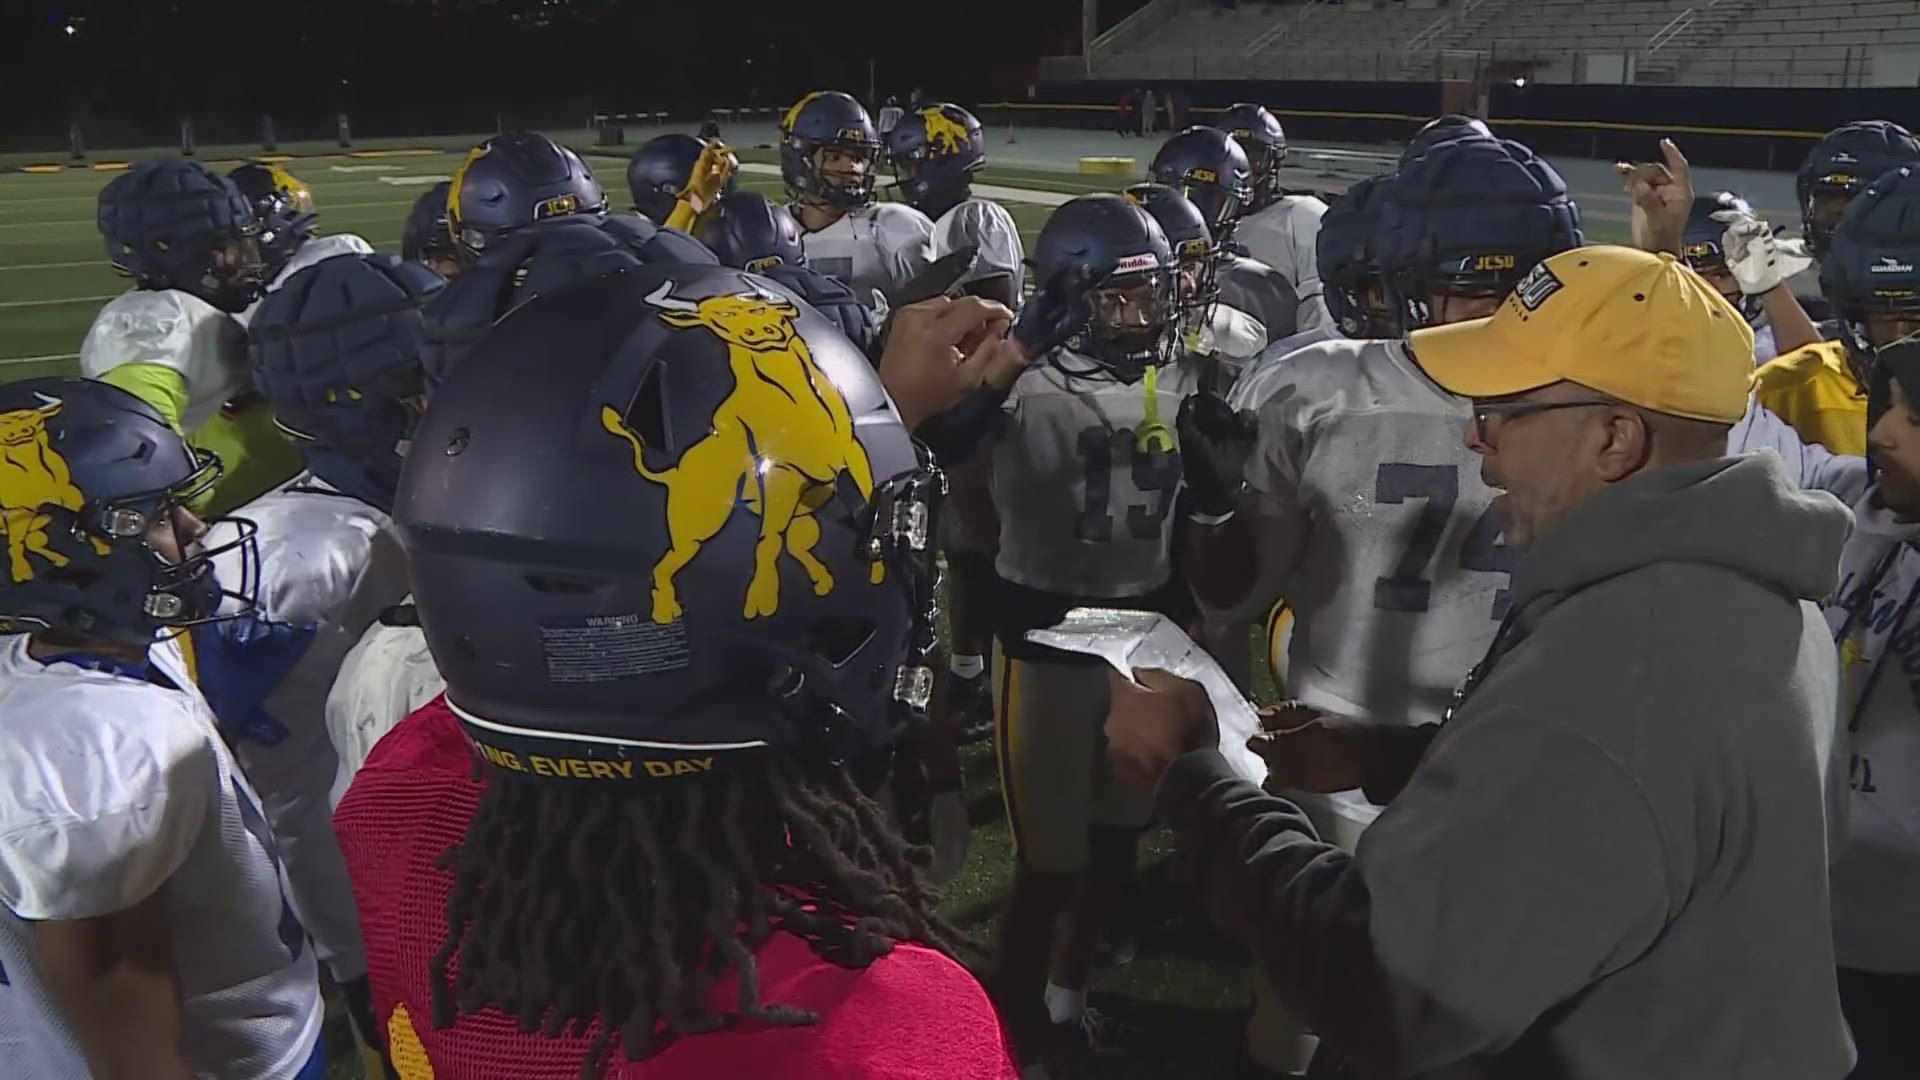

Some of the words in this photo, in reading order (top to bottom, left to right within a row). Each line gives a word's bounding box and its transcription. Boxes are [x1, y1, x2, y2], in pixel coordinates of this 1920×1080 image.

[1475, 255, 1514, 270] JCSU
[1075, 426, 1180, 541] 19
[529, 755, 634, 779] EVERY
[643, 756, 713, 778] DAY
